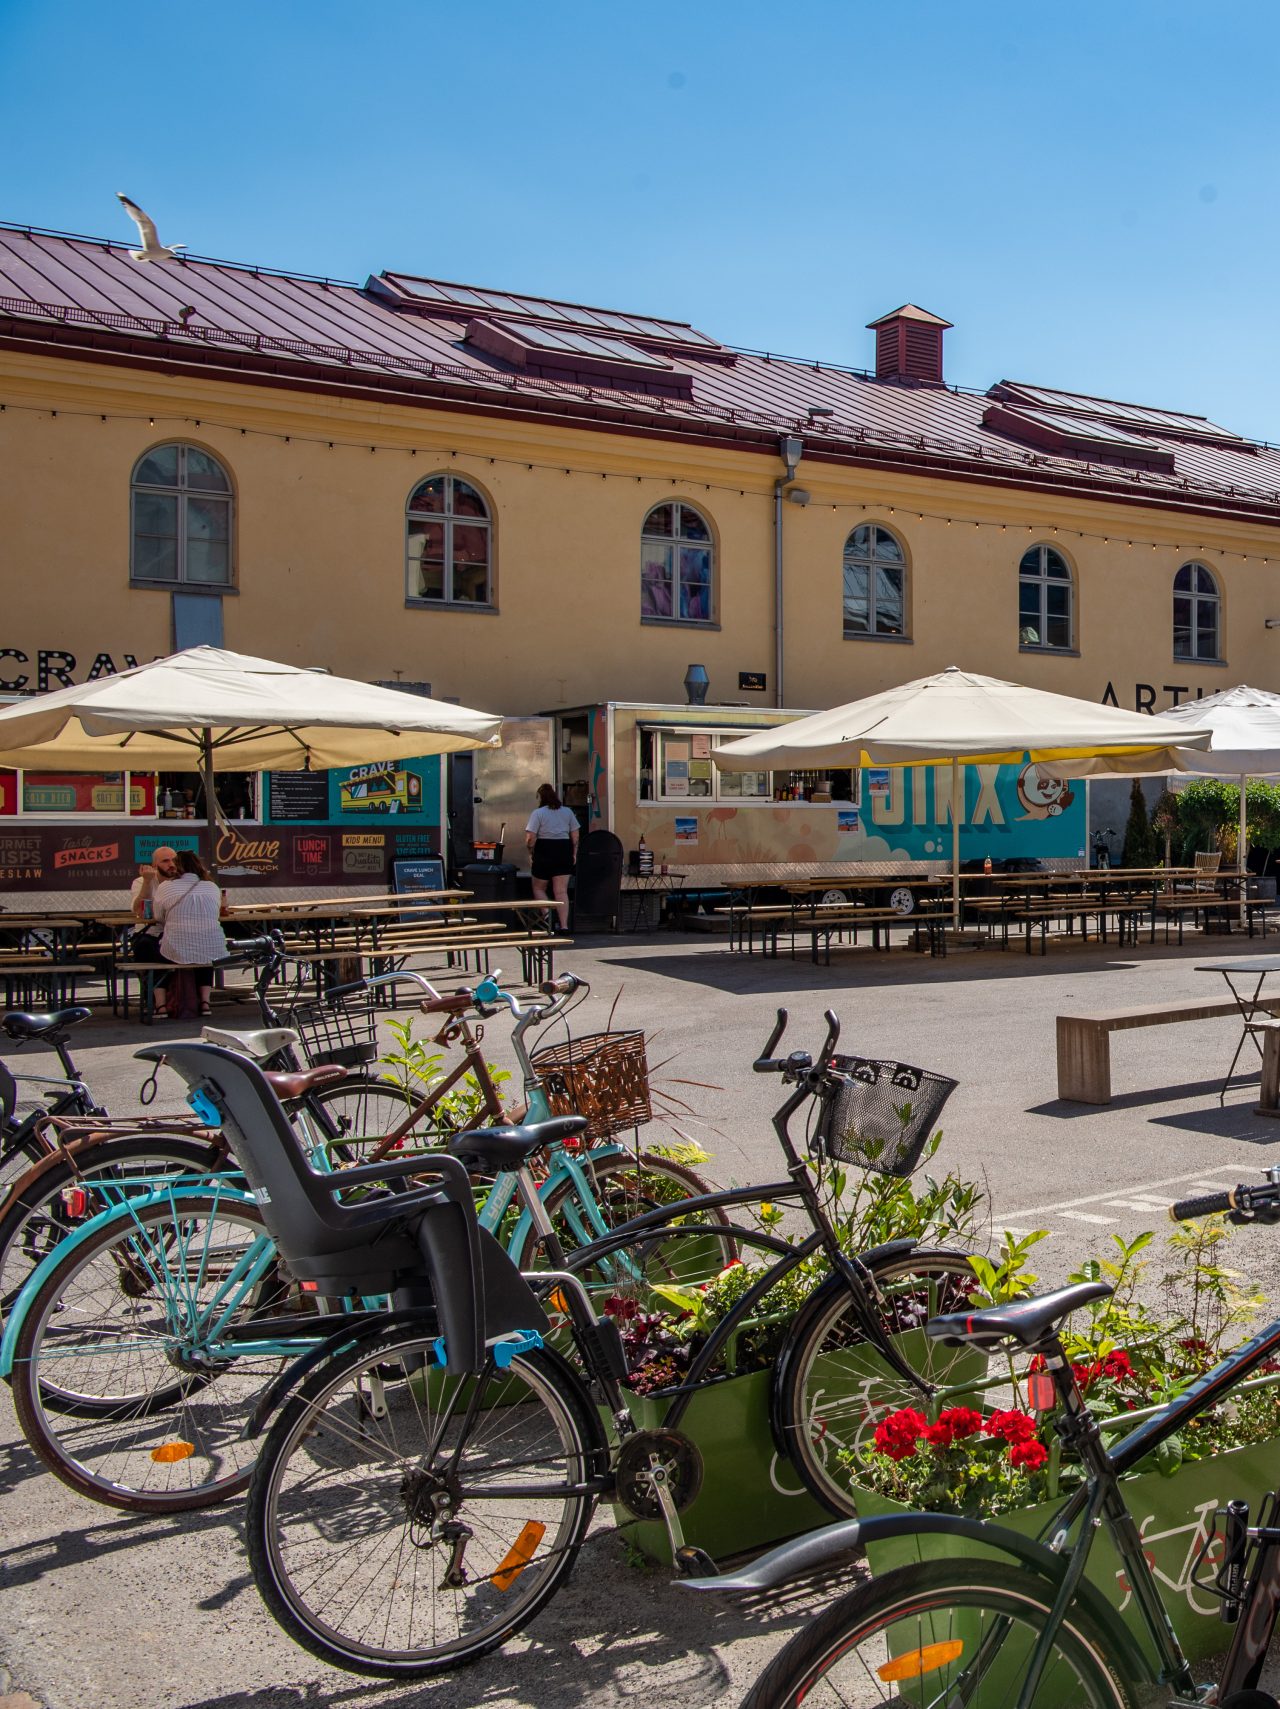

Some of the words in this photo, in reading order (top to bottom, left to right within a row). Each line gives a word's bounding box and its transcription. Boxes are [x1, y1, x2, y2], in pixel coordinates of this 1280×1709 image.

[350, 761, 394, 780] CRAVE
[872, 764, 1005, 825] JINX
[61, 836, 92, 849] Tasty
[176, 840, 189, 849] you
[297, 839, 327, 851] LUNCH
[345, 836, 361, 844] KIDS
[362, 836, 382, 844] MENU
[216, 832, 280, 863] Crave
[60, 847, 113, 865] SNACKS
[302, 851, 323, 863] TIME
[345, 852, 381, 868] Quality
[67, 869, 134, 878] HOMEMADE
